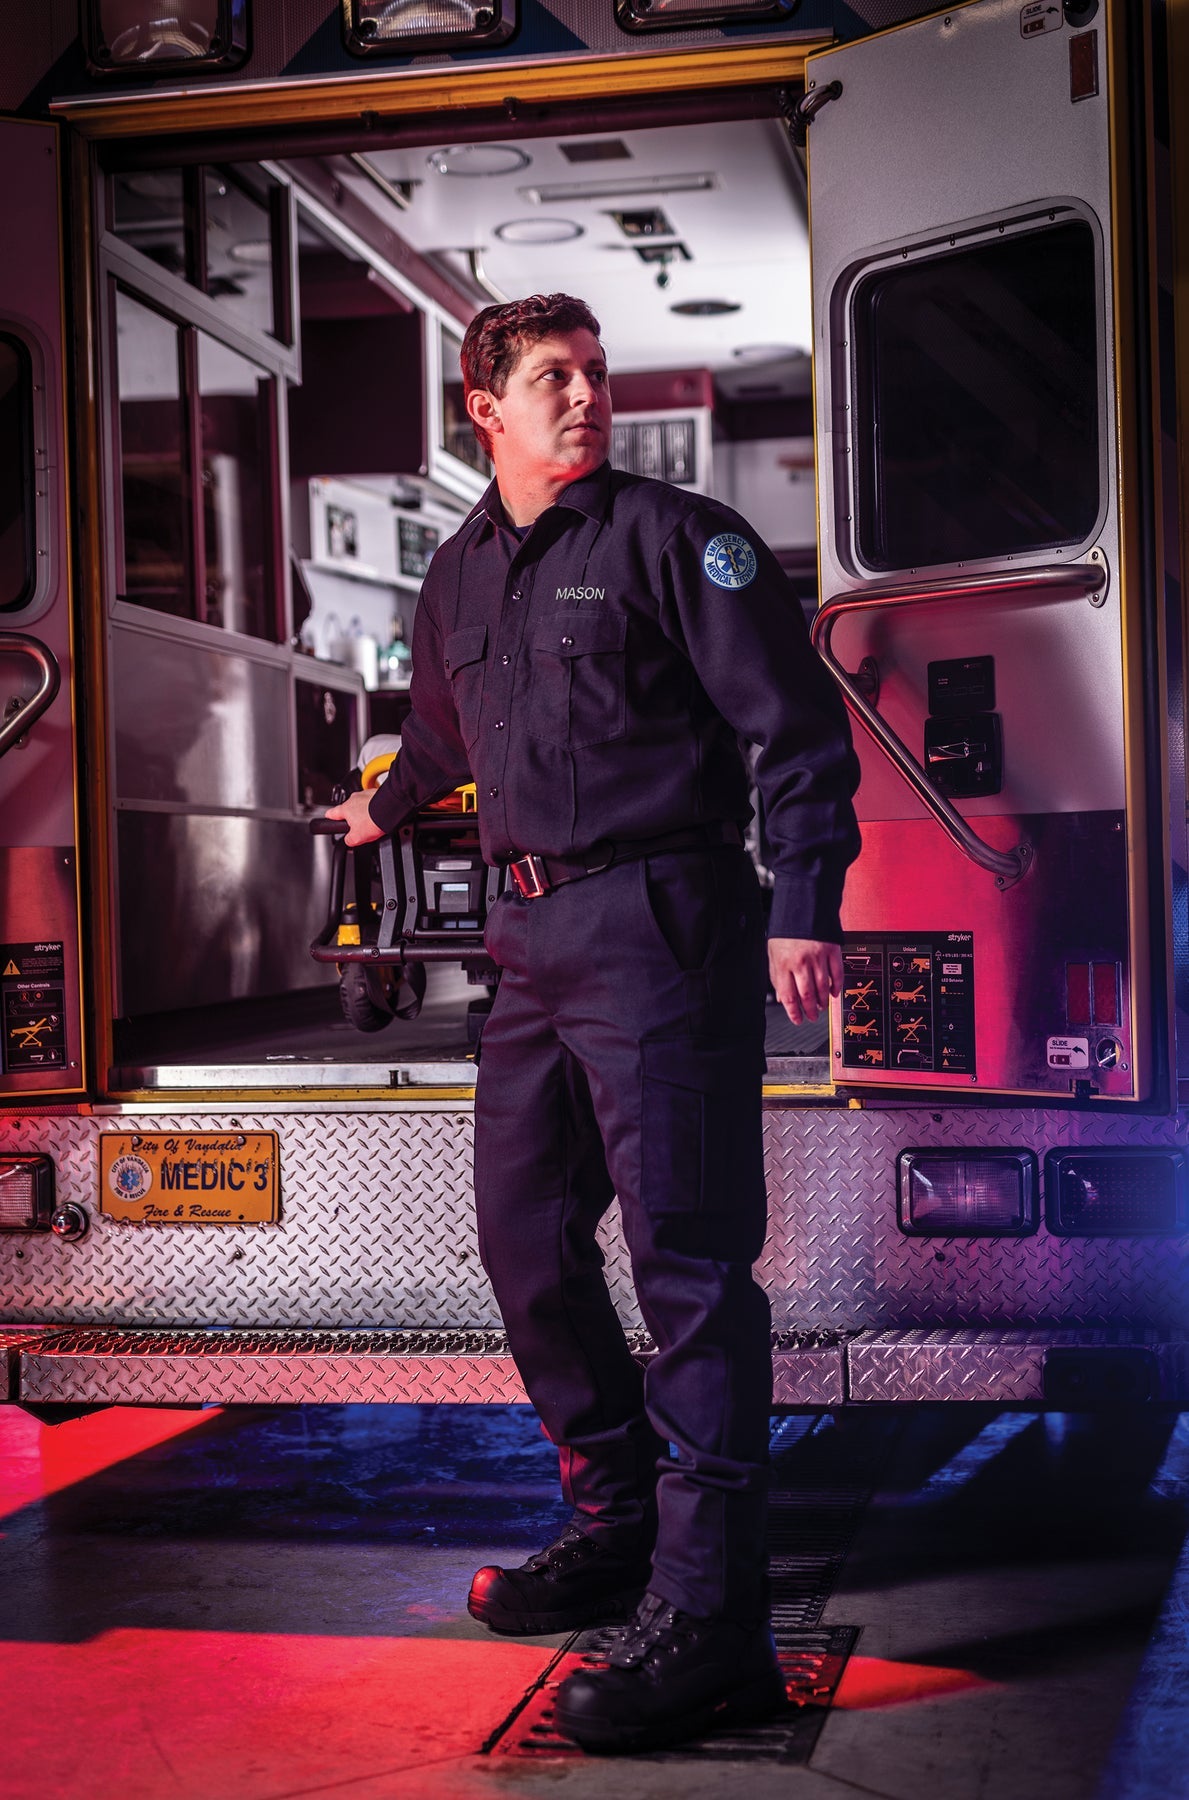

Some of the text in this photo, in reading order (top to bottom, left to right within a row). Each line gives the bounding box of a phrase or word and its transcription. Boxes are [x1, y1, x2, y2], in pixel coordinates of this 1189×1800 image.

[707, 535, 747, 556] EMERGENCY
[706, 561, 732, 585] MEDICAL
[555, 586, 605, 600] MASON
[947, 933, 972, 942] stryker
[34, 944, 61, 952] stryker
[164, 1138, 180, 1154] Of
[184, 1139, 243, 1152] Vandalia
[160, 1161, 268, 1191] MEDIC 3
[143, 1204, 232, 1218] Fire & Rescue
